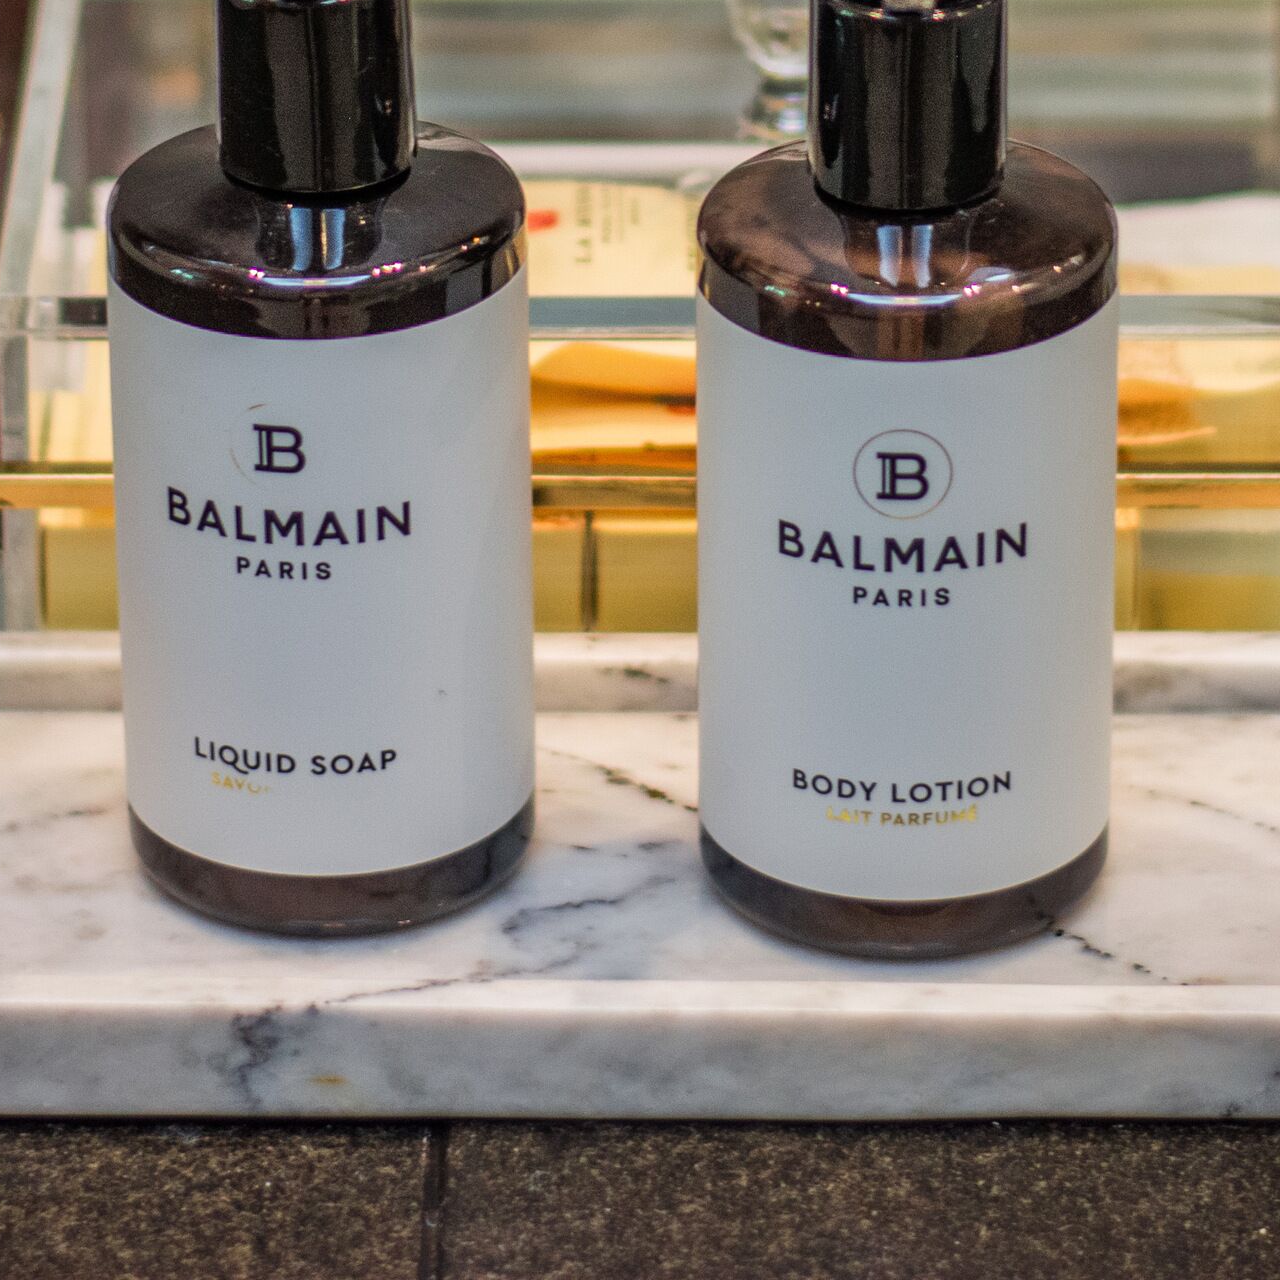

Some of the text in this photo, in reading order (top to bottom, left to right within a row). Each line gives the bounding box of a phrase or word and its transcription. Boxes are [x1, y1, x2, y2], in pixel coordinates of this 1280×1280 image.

[252, 423, 307, 474] B
[875, 451, 930, 501] B
[166, 485, 412, 547] BALMAIN
[778, 518, 1028, 574] BALMAIN
[235, 555, 332, 581] PARIS
[852, 585, 951, 608] PARIS
[194, 735, 398, 776] LIQUID SOAP
[792, 767, 1012, 804] BODY LOTION
[825, 805, 873, 825] LAIT
